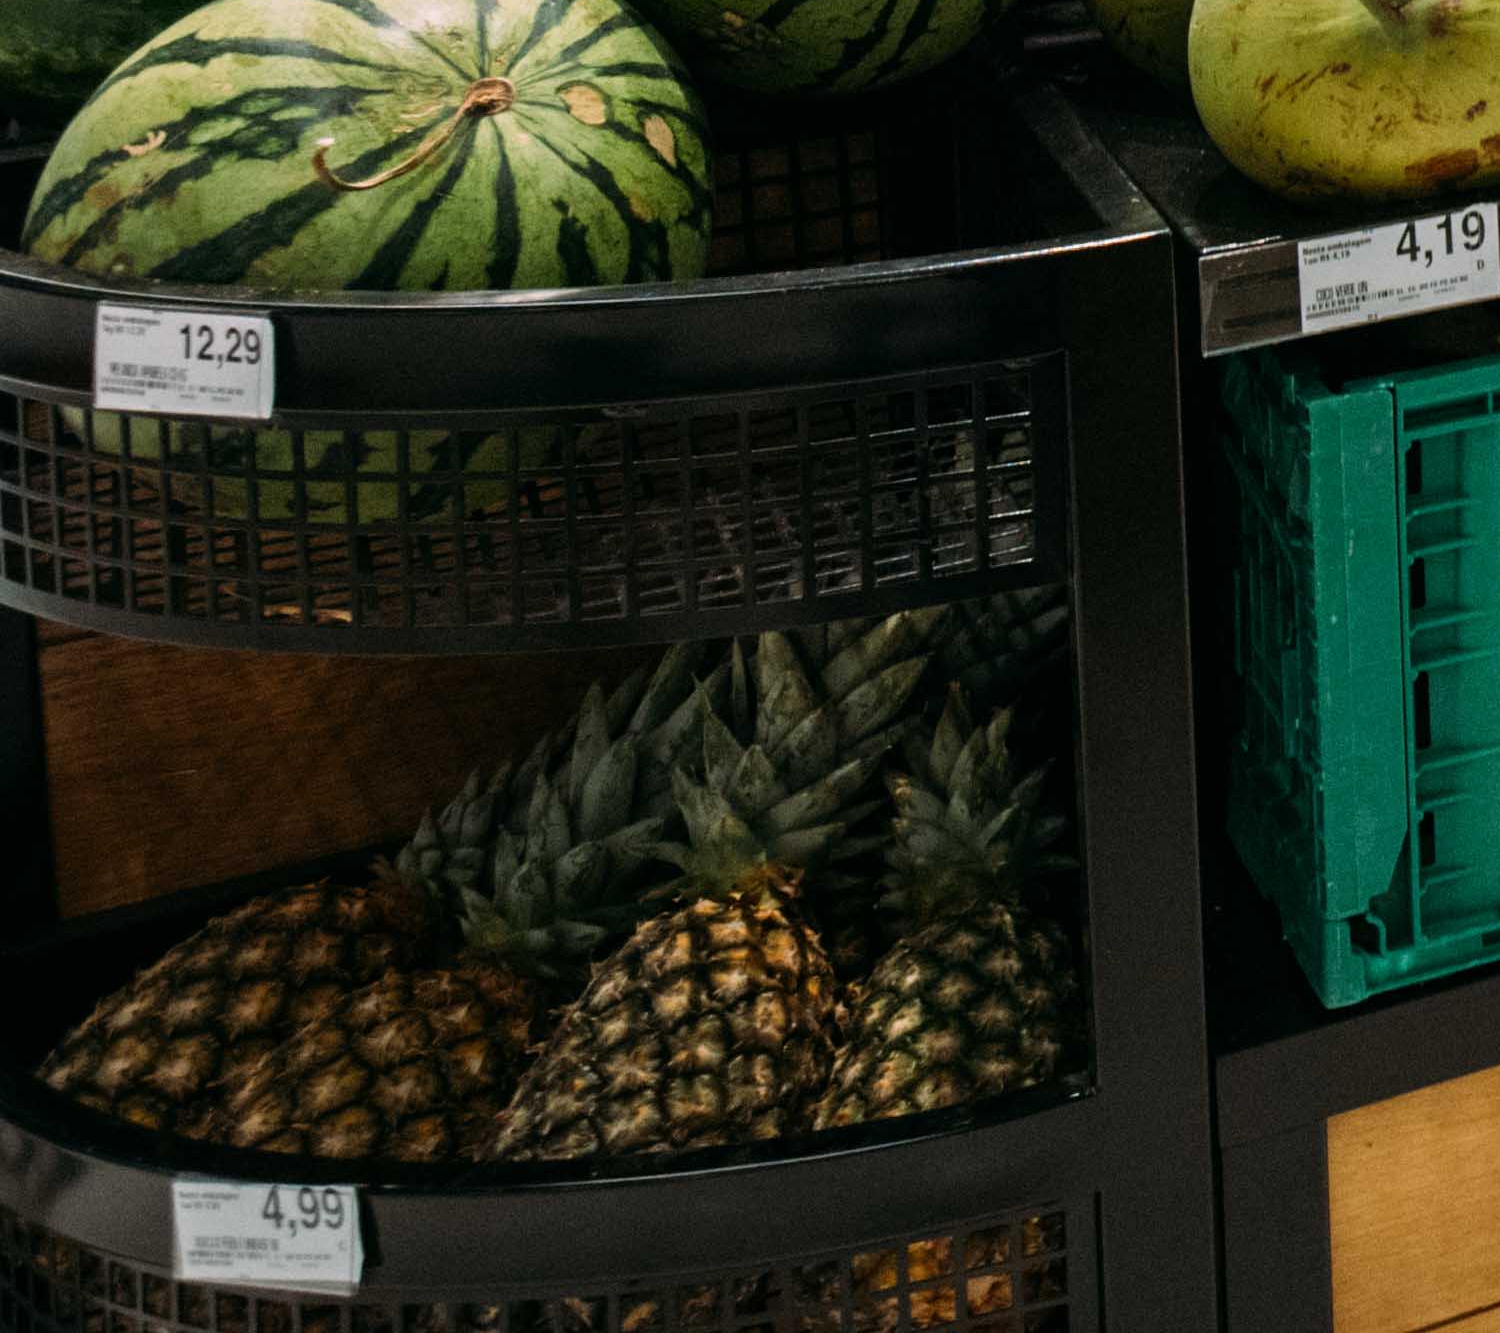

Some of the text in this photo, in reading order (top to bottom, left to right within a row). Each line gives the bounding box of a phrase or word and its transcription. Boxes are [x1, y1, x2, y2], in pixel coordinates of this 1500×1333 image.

[1396, 210, 1486, 268] 4,19
[180, 323, 262, 369] 12,29
[262, 1185, 345, 1237] 4,99
